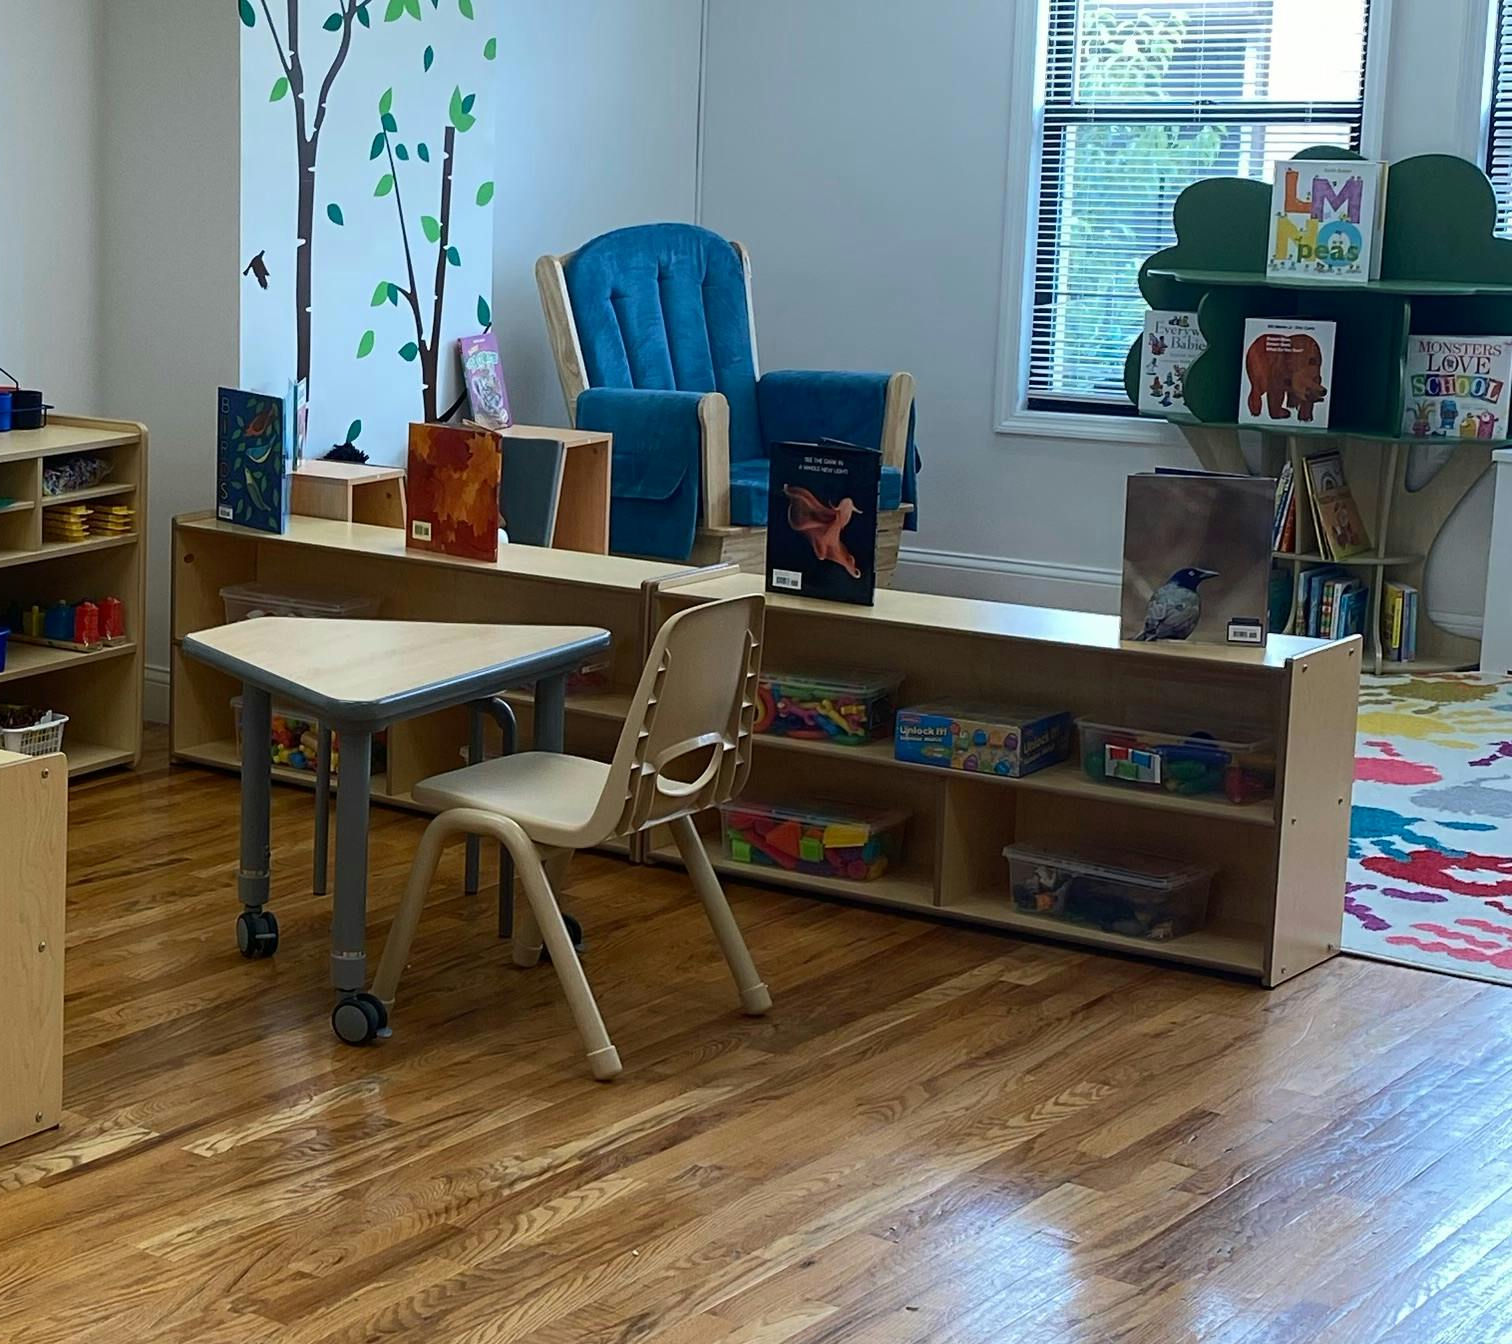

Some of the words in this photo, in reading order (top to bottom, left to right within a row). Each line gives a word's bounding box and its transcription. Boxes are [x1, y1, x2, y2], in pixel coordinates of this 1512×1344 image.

[1296, 242, 1361, 264] peas
[1155, 320, 1200, 338] Everyw
[1171, 335, 1208, 351] Babie
[1418, 340, 1502, 356] MONSTERS
[1425, 353, 1491, 375] LOVE
[1412, 376, 1501, 402] SCHOOL
[899, 725, 934, 737] Unlock
